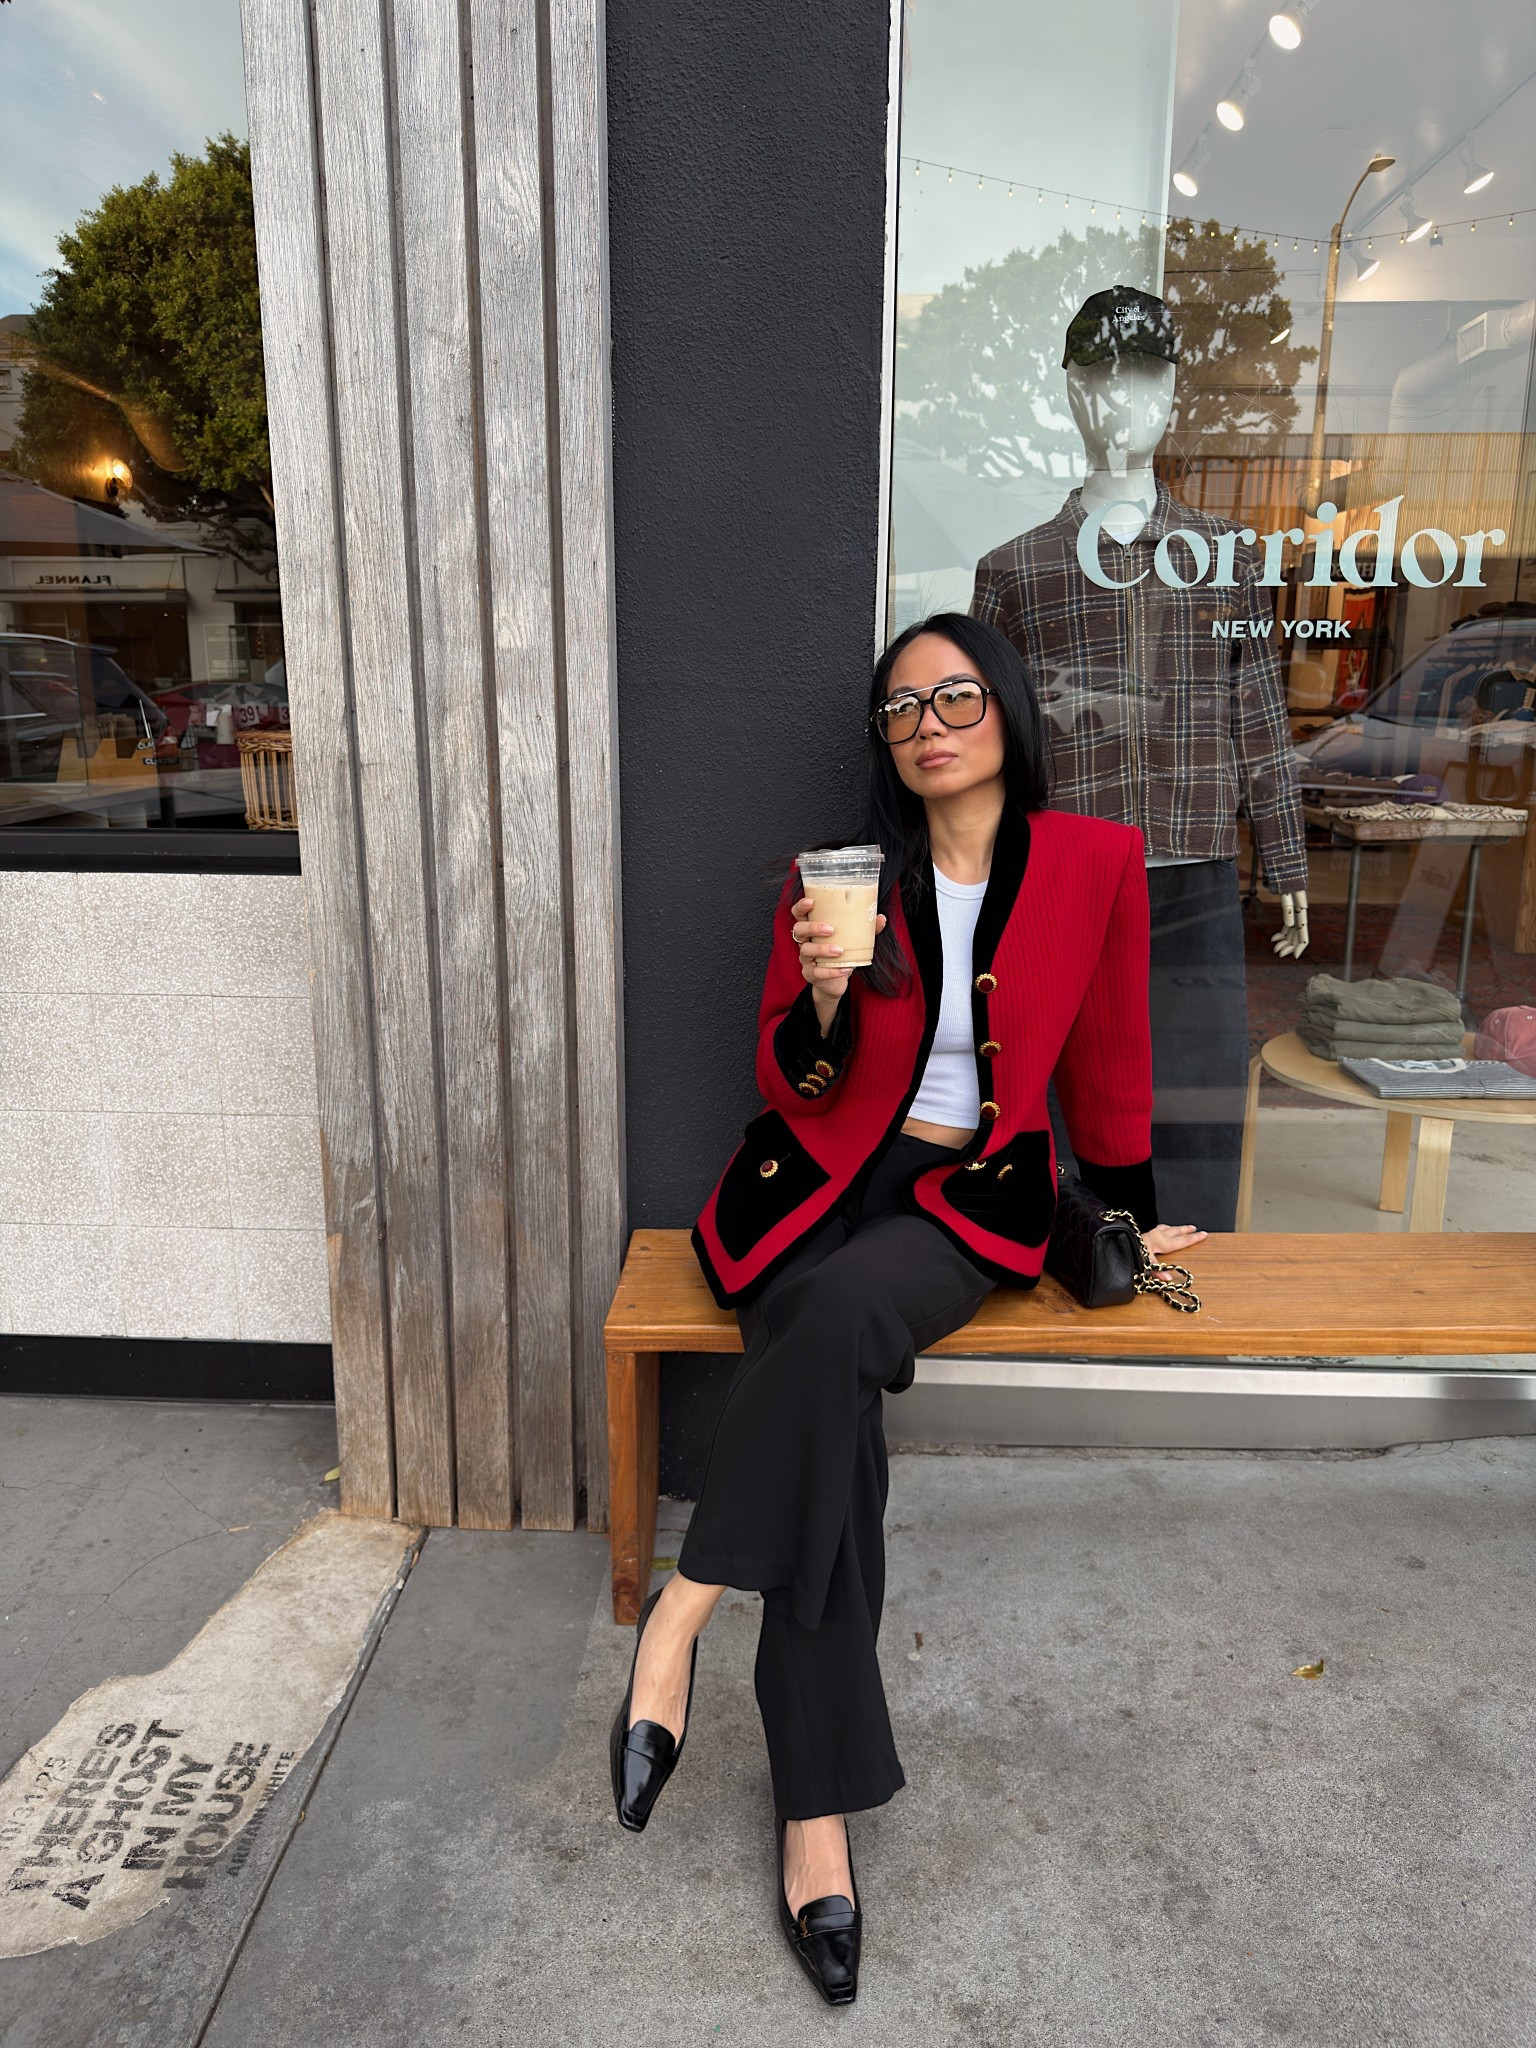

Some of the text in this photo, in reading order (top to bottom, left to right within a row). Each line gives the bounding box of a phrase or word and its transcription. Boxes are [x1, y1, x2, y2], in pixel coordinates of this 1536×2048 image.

[1077, 494, 1507, 589] Corridor
[1211, 620, 1352, 639] NEW YORK
[52, 1719, 184, 1910] A GHOST
[121, 1753, 214, 1870] IN MY
[162, 1741, 272, 1890] HOUSE
[259, 1750, 296, 1808] WHITE
